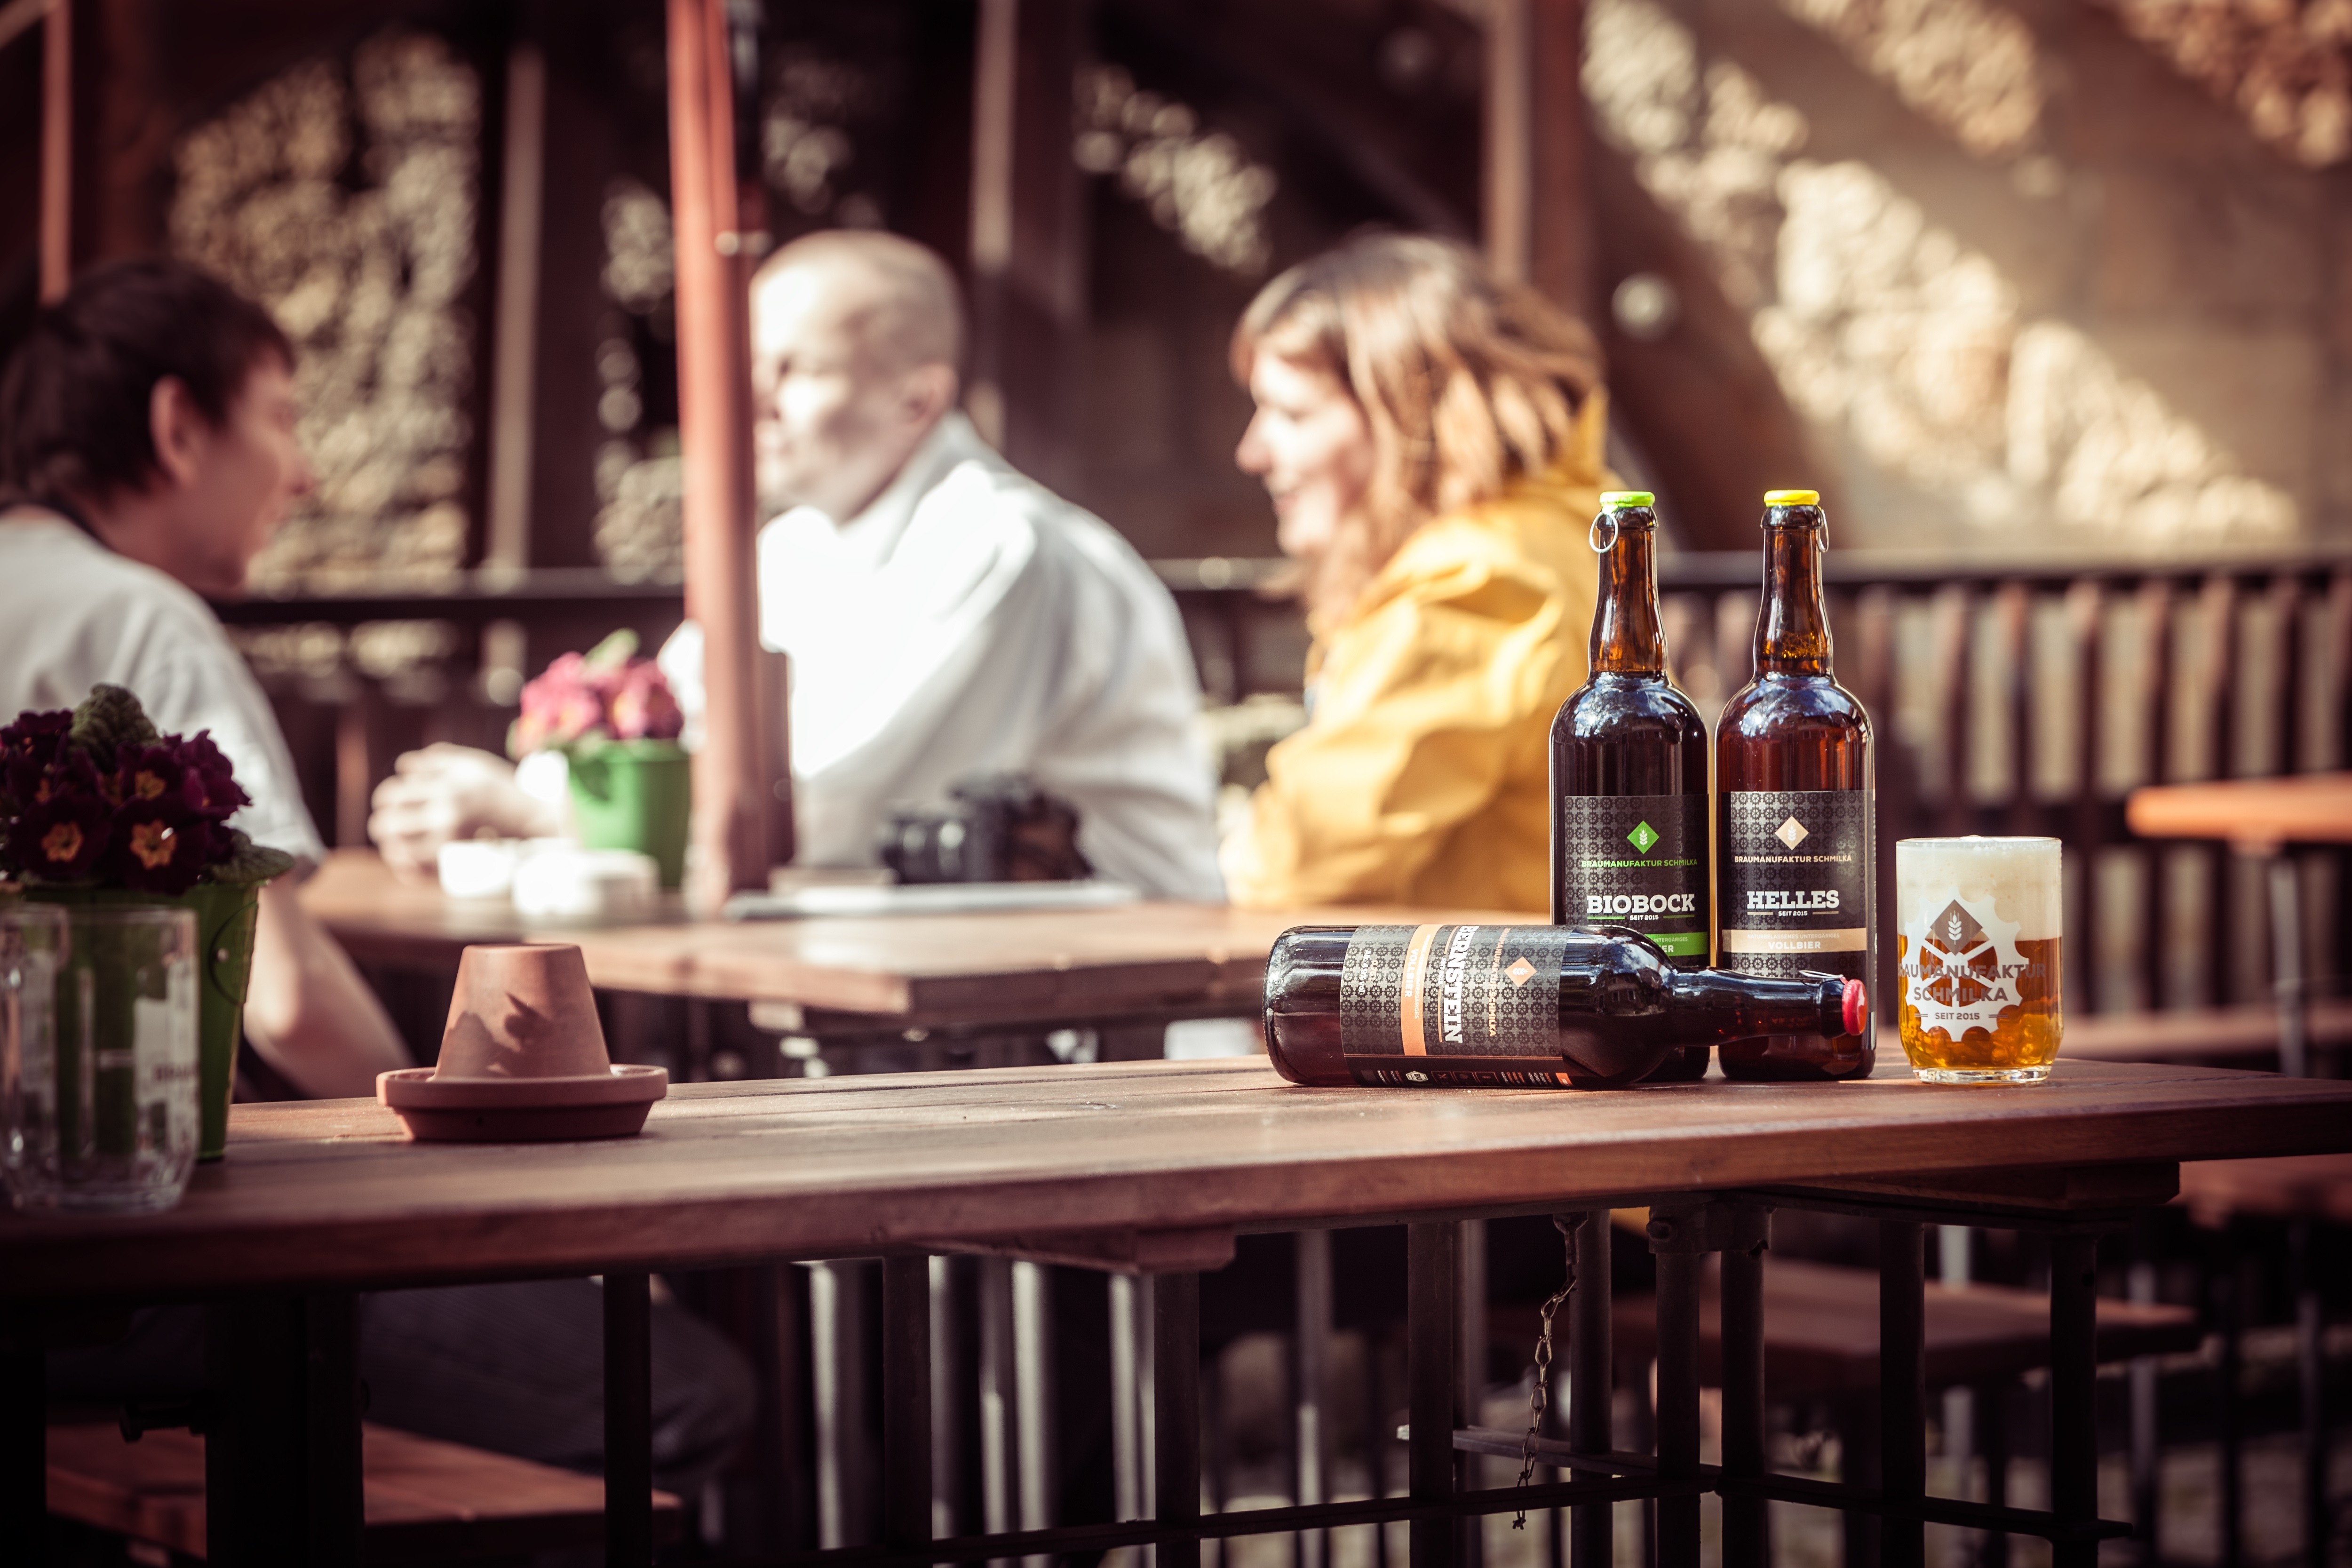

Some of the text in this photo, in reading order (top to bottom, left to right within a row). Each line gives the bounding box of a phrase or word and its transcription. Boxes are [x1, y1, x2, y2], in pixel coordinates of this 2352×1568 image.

[1587, 893, 1695, 914] BIOBOCK
[1747, 890, 1840, 909] HELLES
[1768, 941, 1821, 950] VOLLBIER
[1405, 948, 1419, 997] VOLLBIER
[1444, 925, 1479, 1043] BERNSTEIN
[1914, 987, 2008, 1001] SCHMILKA
